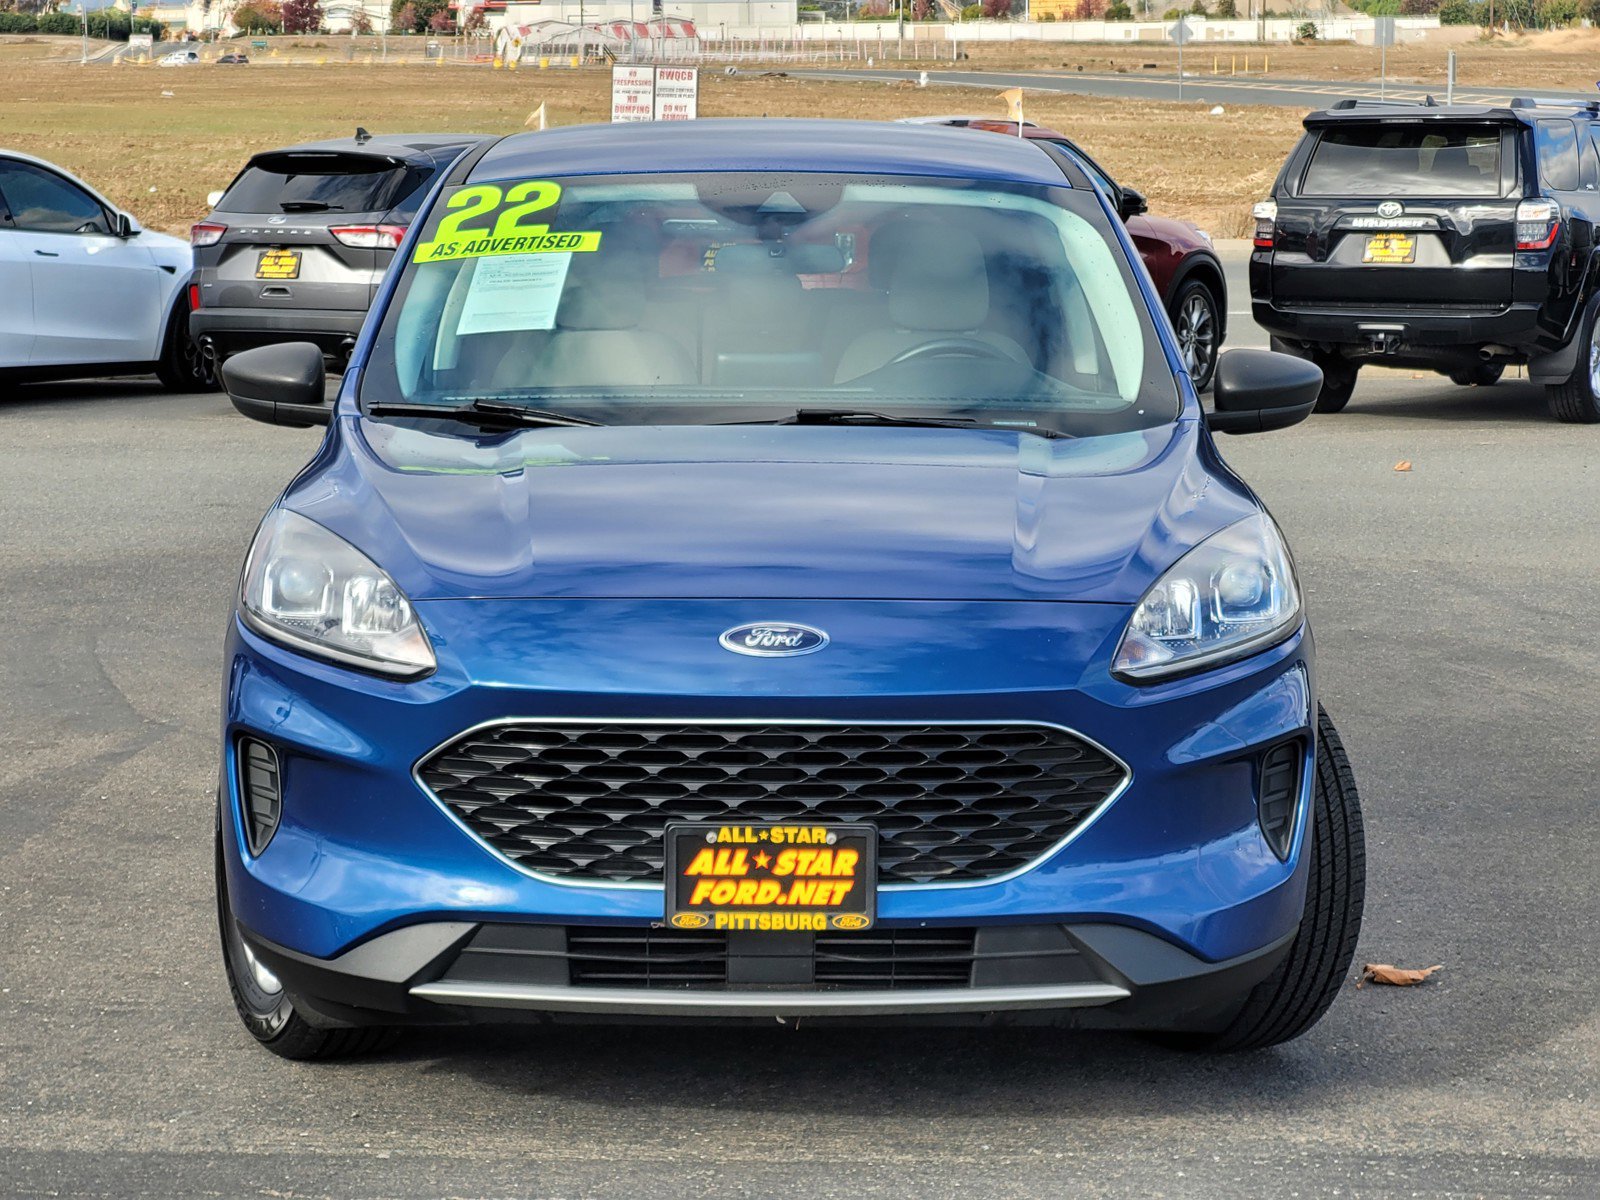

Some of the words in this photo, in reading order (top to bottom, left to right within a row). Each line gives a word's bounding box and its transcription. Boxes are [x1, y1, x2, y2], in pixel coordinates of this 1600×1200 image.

[659, 70, 693, 81] RWQCB
[627, 95, 638, 103] NO
[663, 104, 673, 112] DO
[614, 105, 650, 114] DUMPING
[435, 180, 561, 242] 22
[430, 241, 461, 258] AS
[462, 234, 584, 256] ADVERTISED
[745, 627, 803, 647] Ford
[717, 826, 758, 844] ALL
[770, 826, 827, 844] STAR
[684, 848, 750, 876] ALL
[771, 848, 859, 876] STAR
[689, 879, 855, 906] FORD.NET
[714, 912, 827, 931] PITTSBURG
